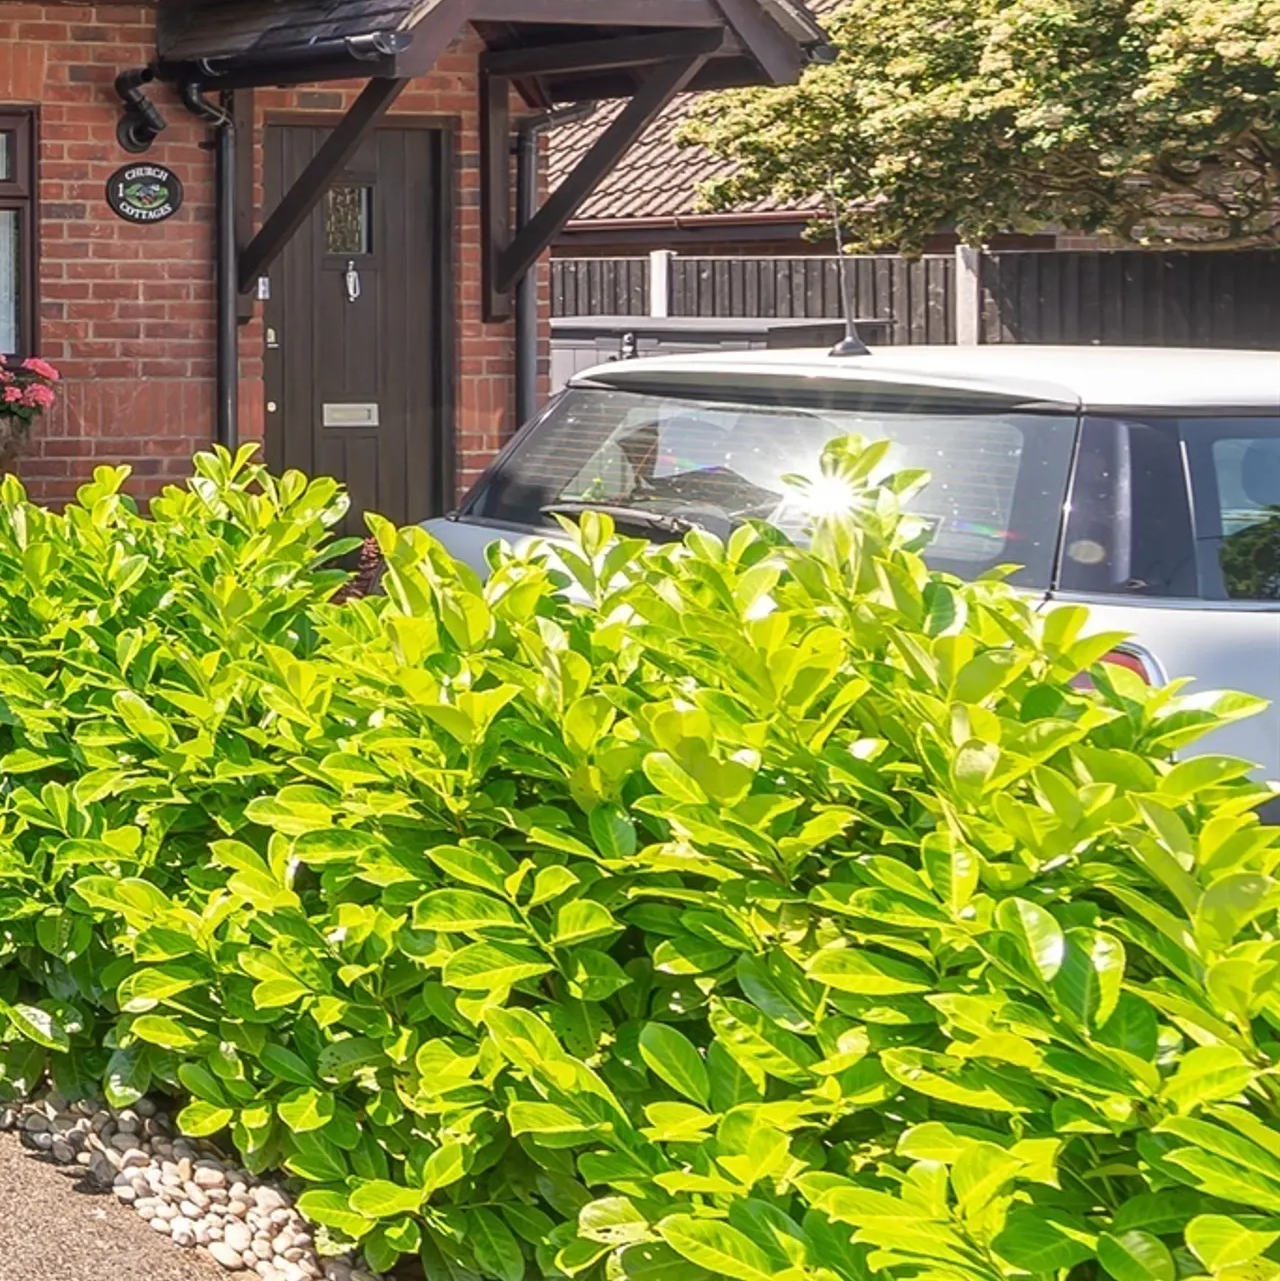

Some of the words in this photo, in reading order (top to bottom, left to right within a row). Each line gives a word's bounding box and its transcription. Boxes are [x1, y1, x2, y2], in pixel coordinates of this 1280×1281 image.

[124, 166, 169, 181] CHURCH
[118, 183, 124, 197] 1
[119, 201, 172, 219] COTTAGES
